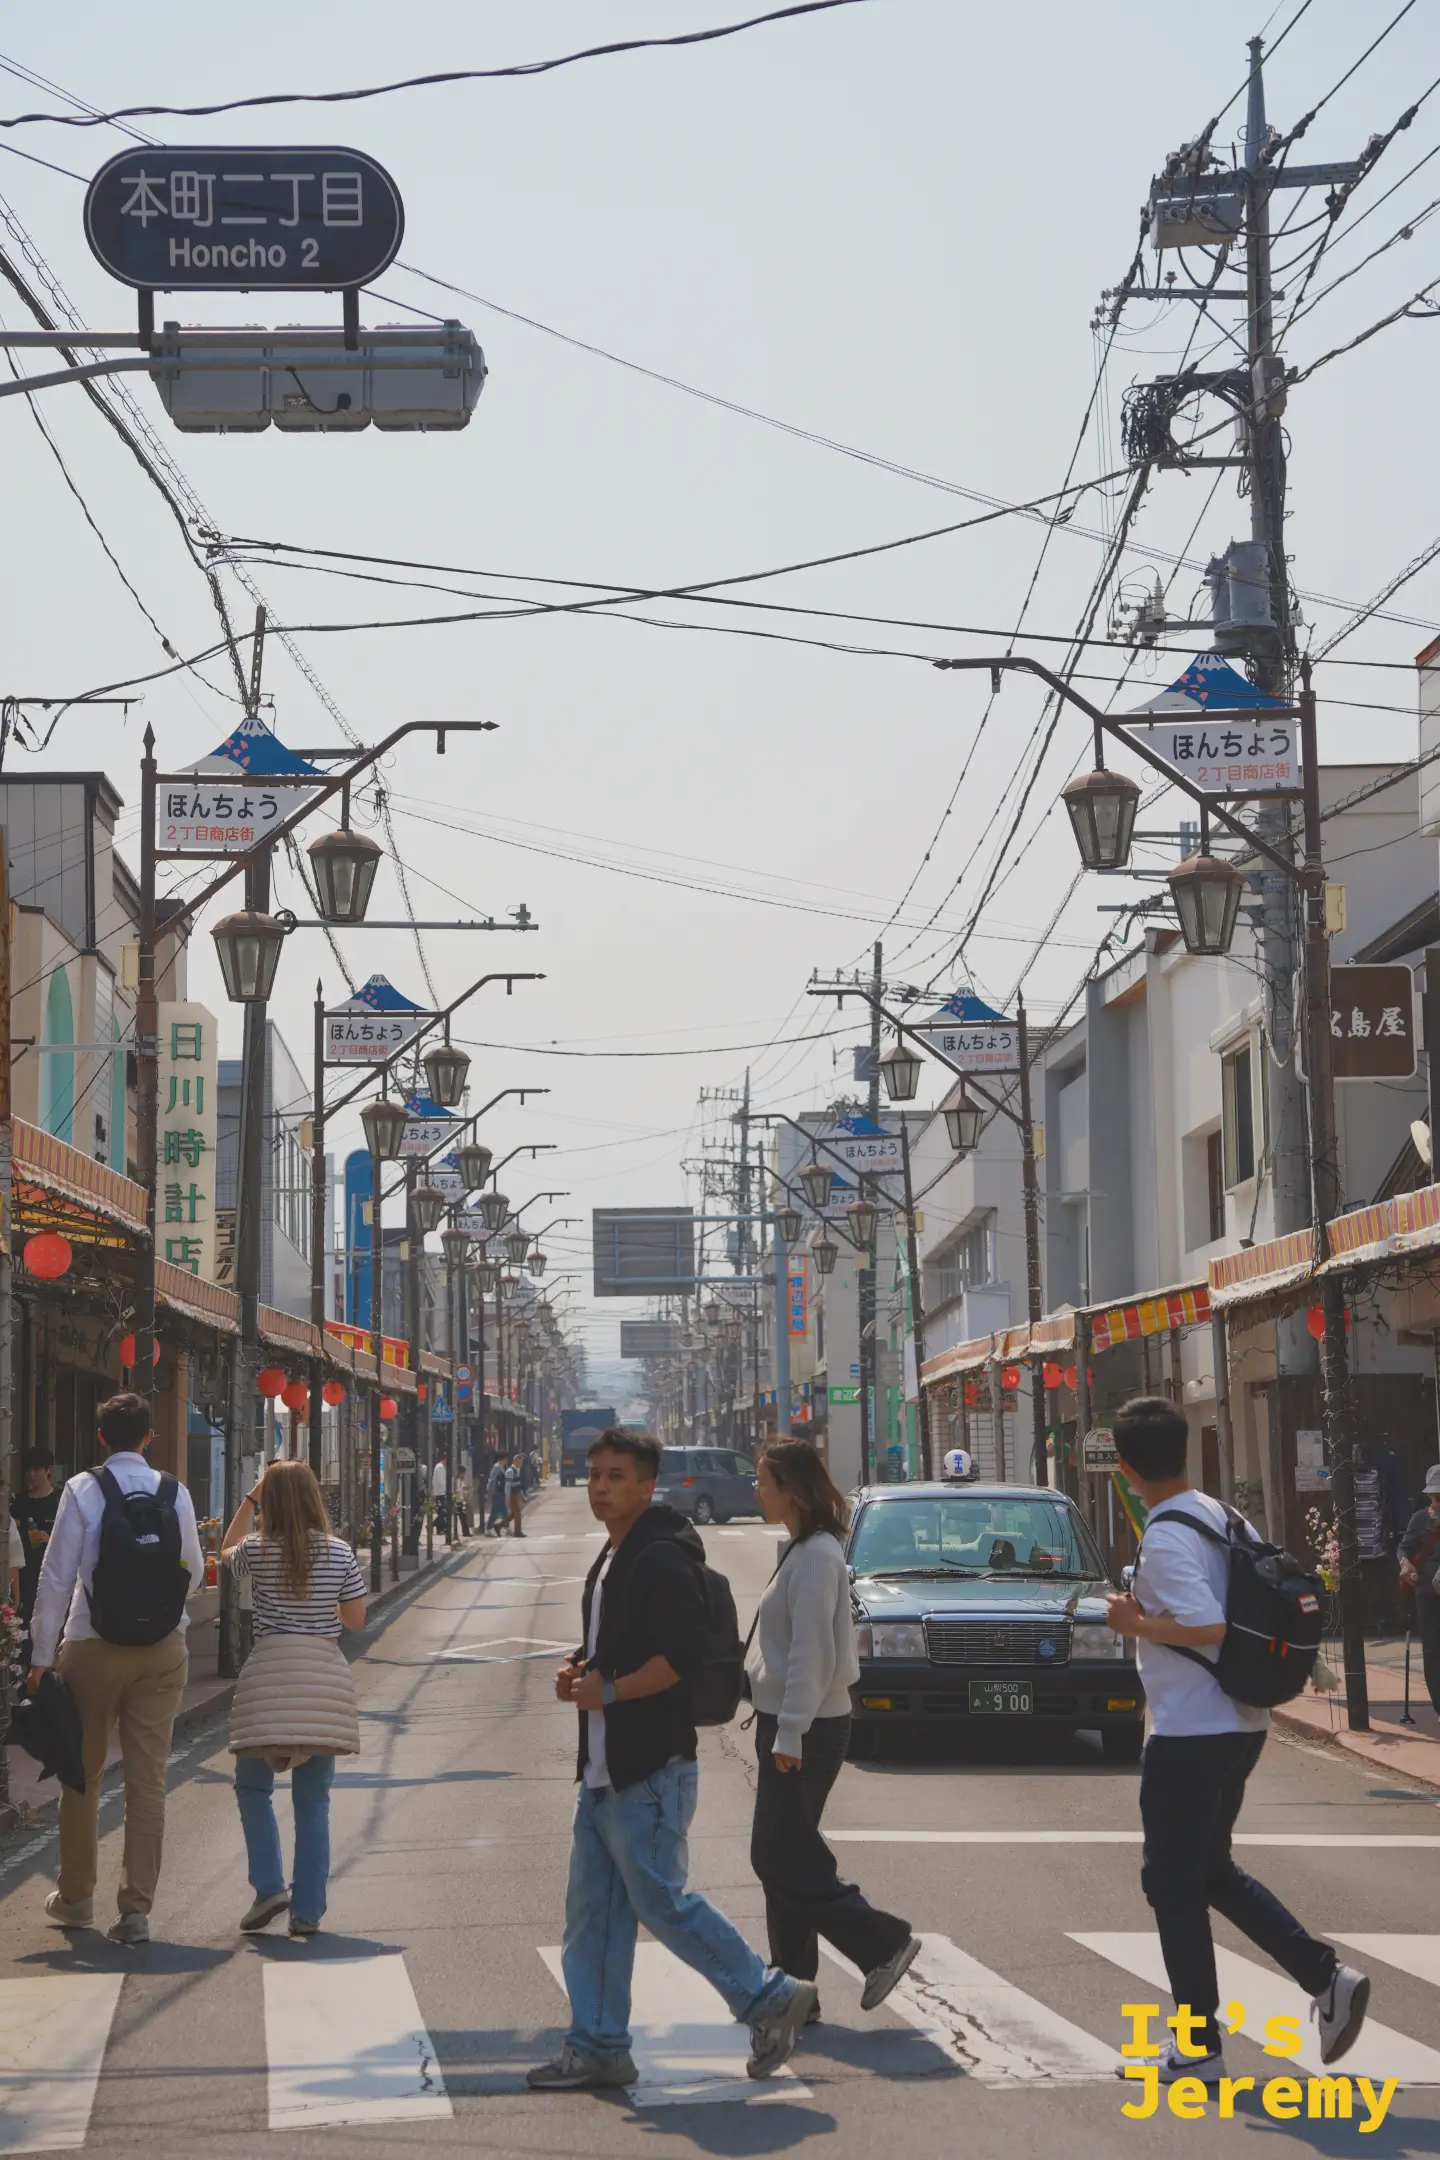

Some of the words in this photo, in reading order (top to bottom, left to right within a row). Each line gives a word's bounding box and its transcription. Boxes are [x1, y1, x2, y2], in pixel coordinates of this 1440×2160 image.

[120, 169, 363, 228] 本町二丁目
[169, 238, 286, 268] Honcho
[301, 238, 320, 267] 2
[1173, 728, 1290, 760] ほんちょう
[1197, 763, 1291, 782] 2丁目商店街
[167, 793, 278, 819] ほんちょう
[167, 825, 255, 841] 2丁目商店街
[331, 1024, 403, 1041] ほんちょう
[943, 1033, 1012, 1051] ほんちょう
[164, 1022, 206, 1276] 日川時計店
[846, 1142, 897, 1158] ほんちょう
